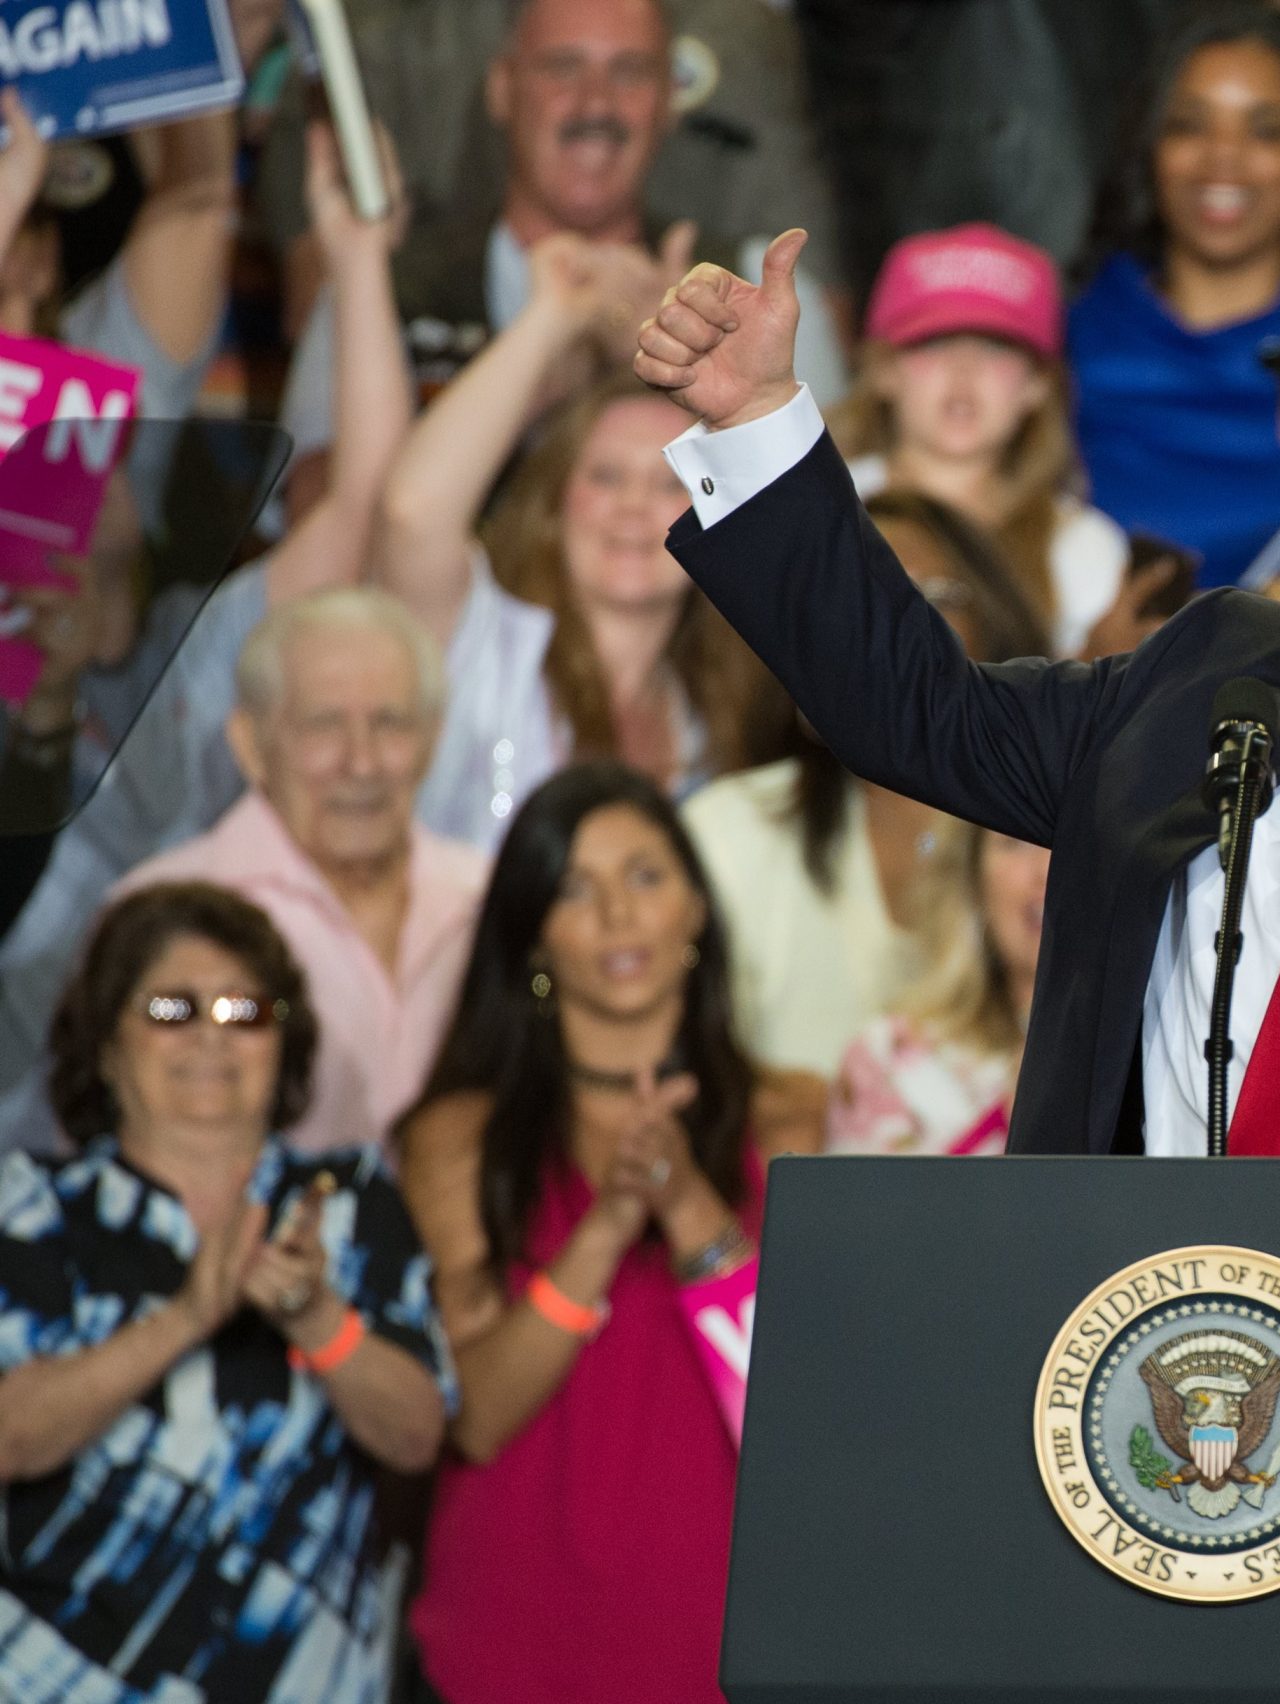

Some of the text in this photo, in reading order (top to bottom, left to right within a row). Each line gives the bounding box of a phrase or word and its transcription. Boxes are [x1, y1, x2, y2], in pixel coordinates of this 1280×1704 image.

[1219, 1262, 1251, 1285] OF
[1048, 1259, 1207, 1413] PRESIDENT
[1052, 1426, 1077, 1475] THE
[1064, 1479, 1092, 1510] OF
[1090, 1508, 1178, 1583] SEAL
